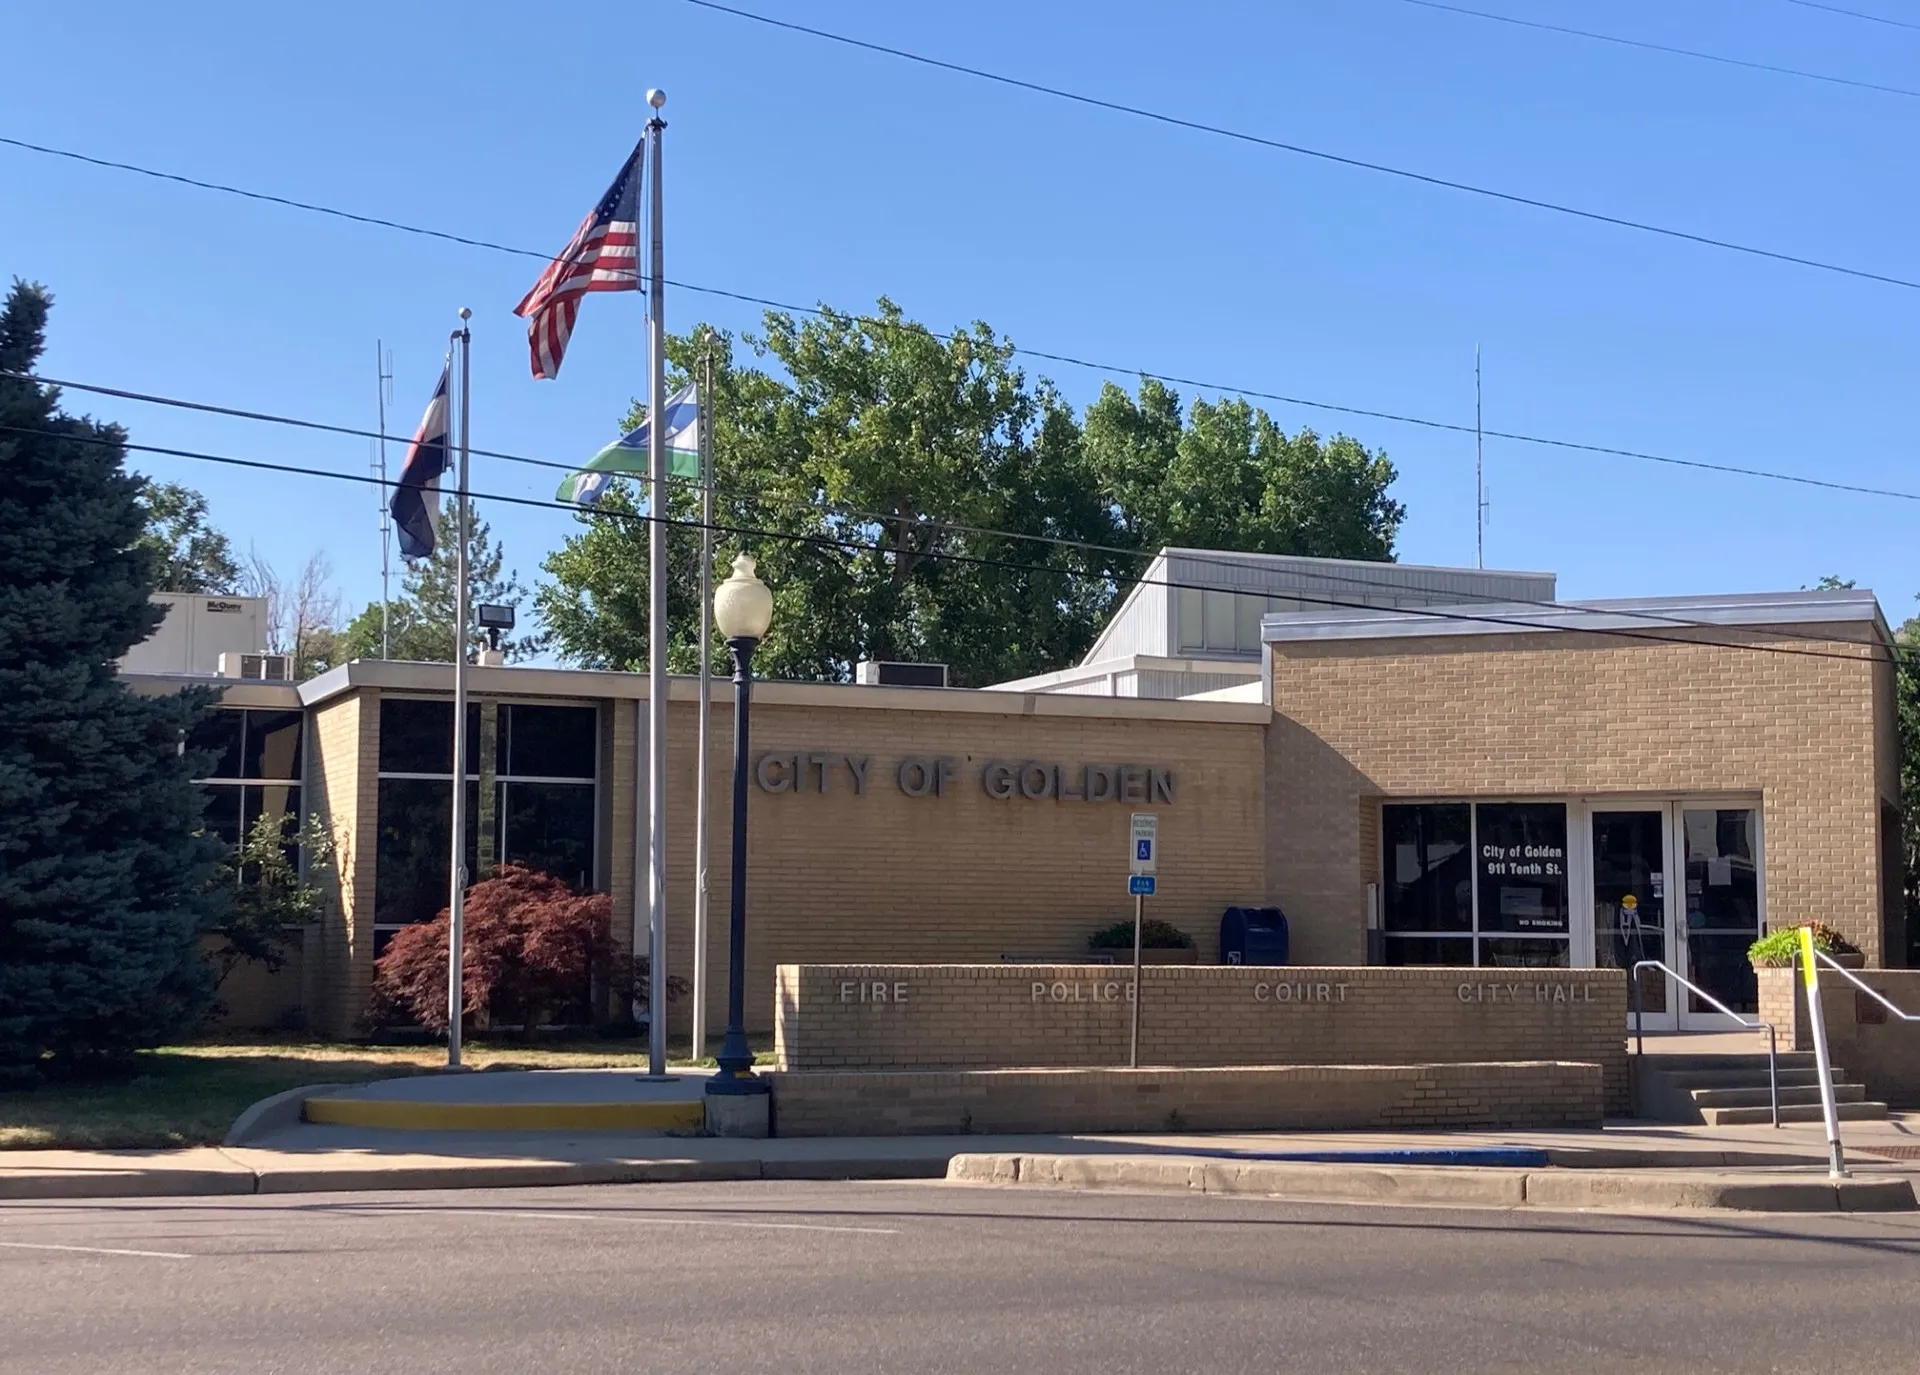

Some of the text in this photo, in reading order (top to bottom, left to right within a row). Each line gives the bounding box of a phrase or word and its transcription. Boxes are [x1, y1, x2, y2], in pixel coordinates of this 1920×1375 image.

[755, 752, 1177, 804] CITY OF GOLDEN
[1483, 845, 1562, 860] City of Golden
[1487, 862, 1562, 875] 911 Tenth St.
[1532, 919, 1564, 927] SMOKING
[840, 981, 1598, 1003] FIRE POLICE COURT CITY HALL
